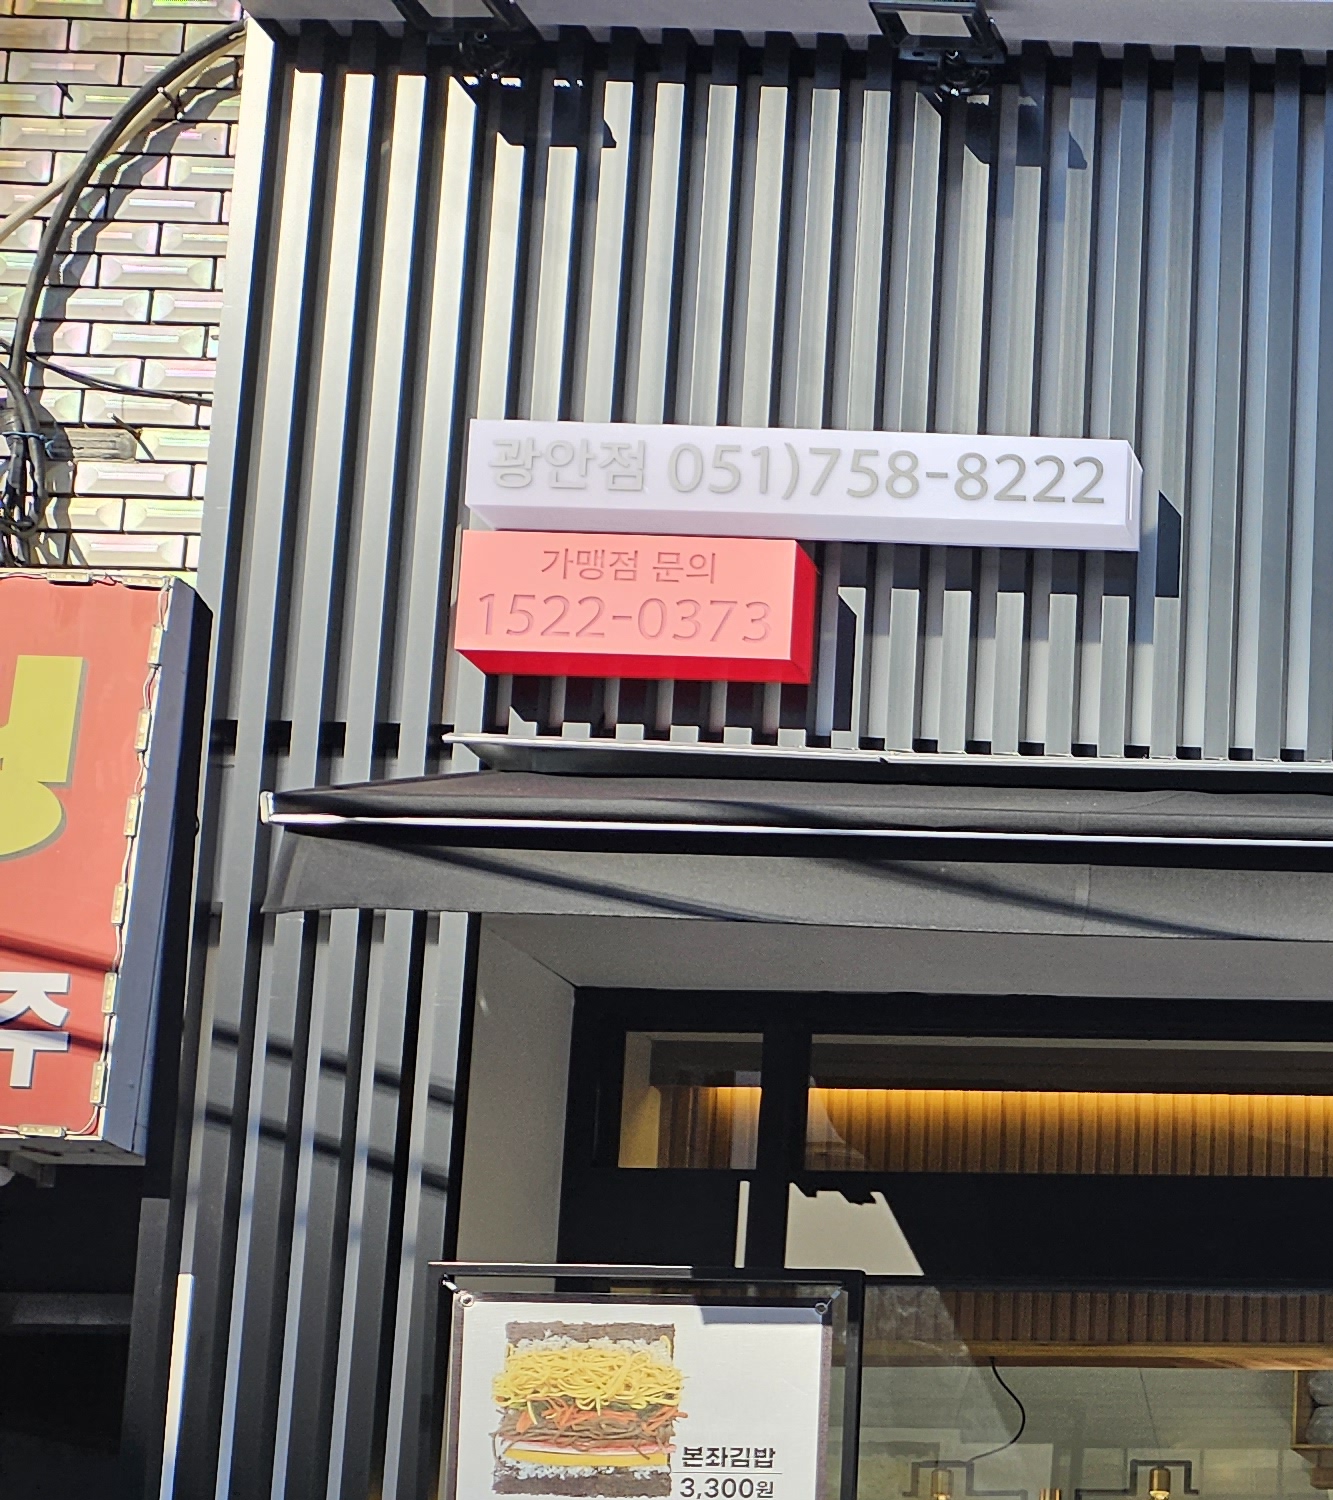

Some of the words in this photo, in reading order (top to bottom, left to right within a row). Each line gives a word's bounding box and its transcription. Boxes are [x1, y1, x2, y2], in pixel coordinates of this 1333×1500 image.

[489, 436, 648, 492] 광안점
[667, 442, 1106, 504] 051)758-8222
[541, 546, 639, 583] 가맹점
[652, 549, 717, 585] 문의
[477, 591, 772, 645] 1522-0373
[681, 1446, 777, 1469] 본좌김밥
[680, 1478, 775, 1500] 3,300원
